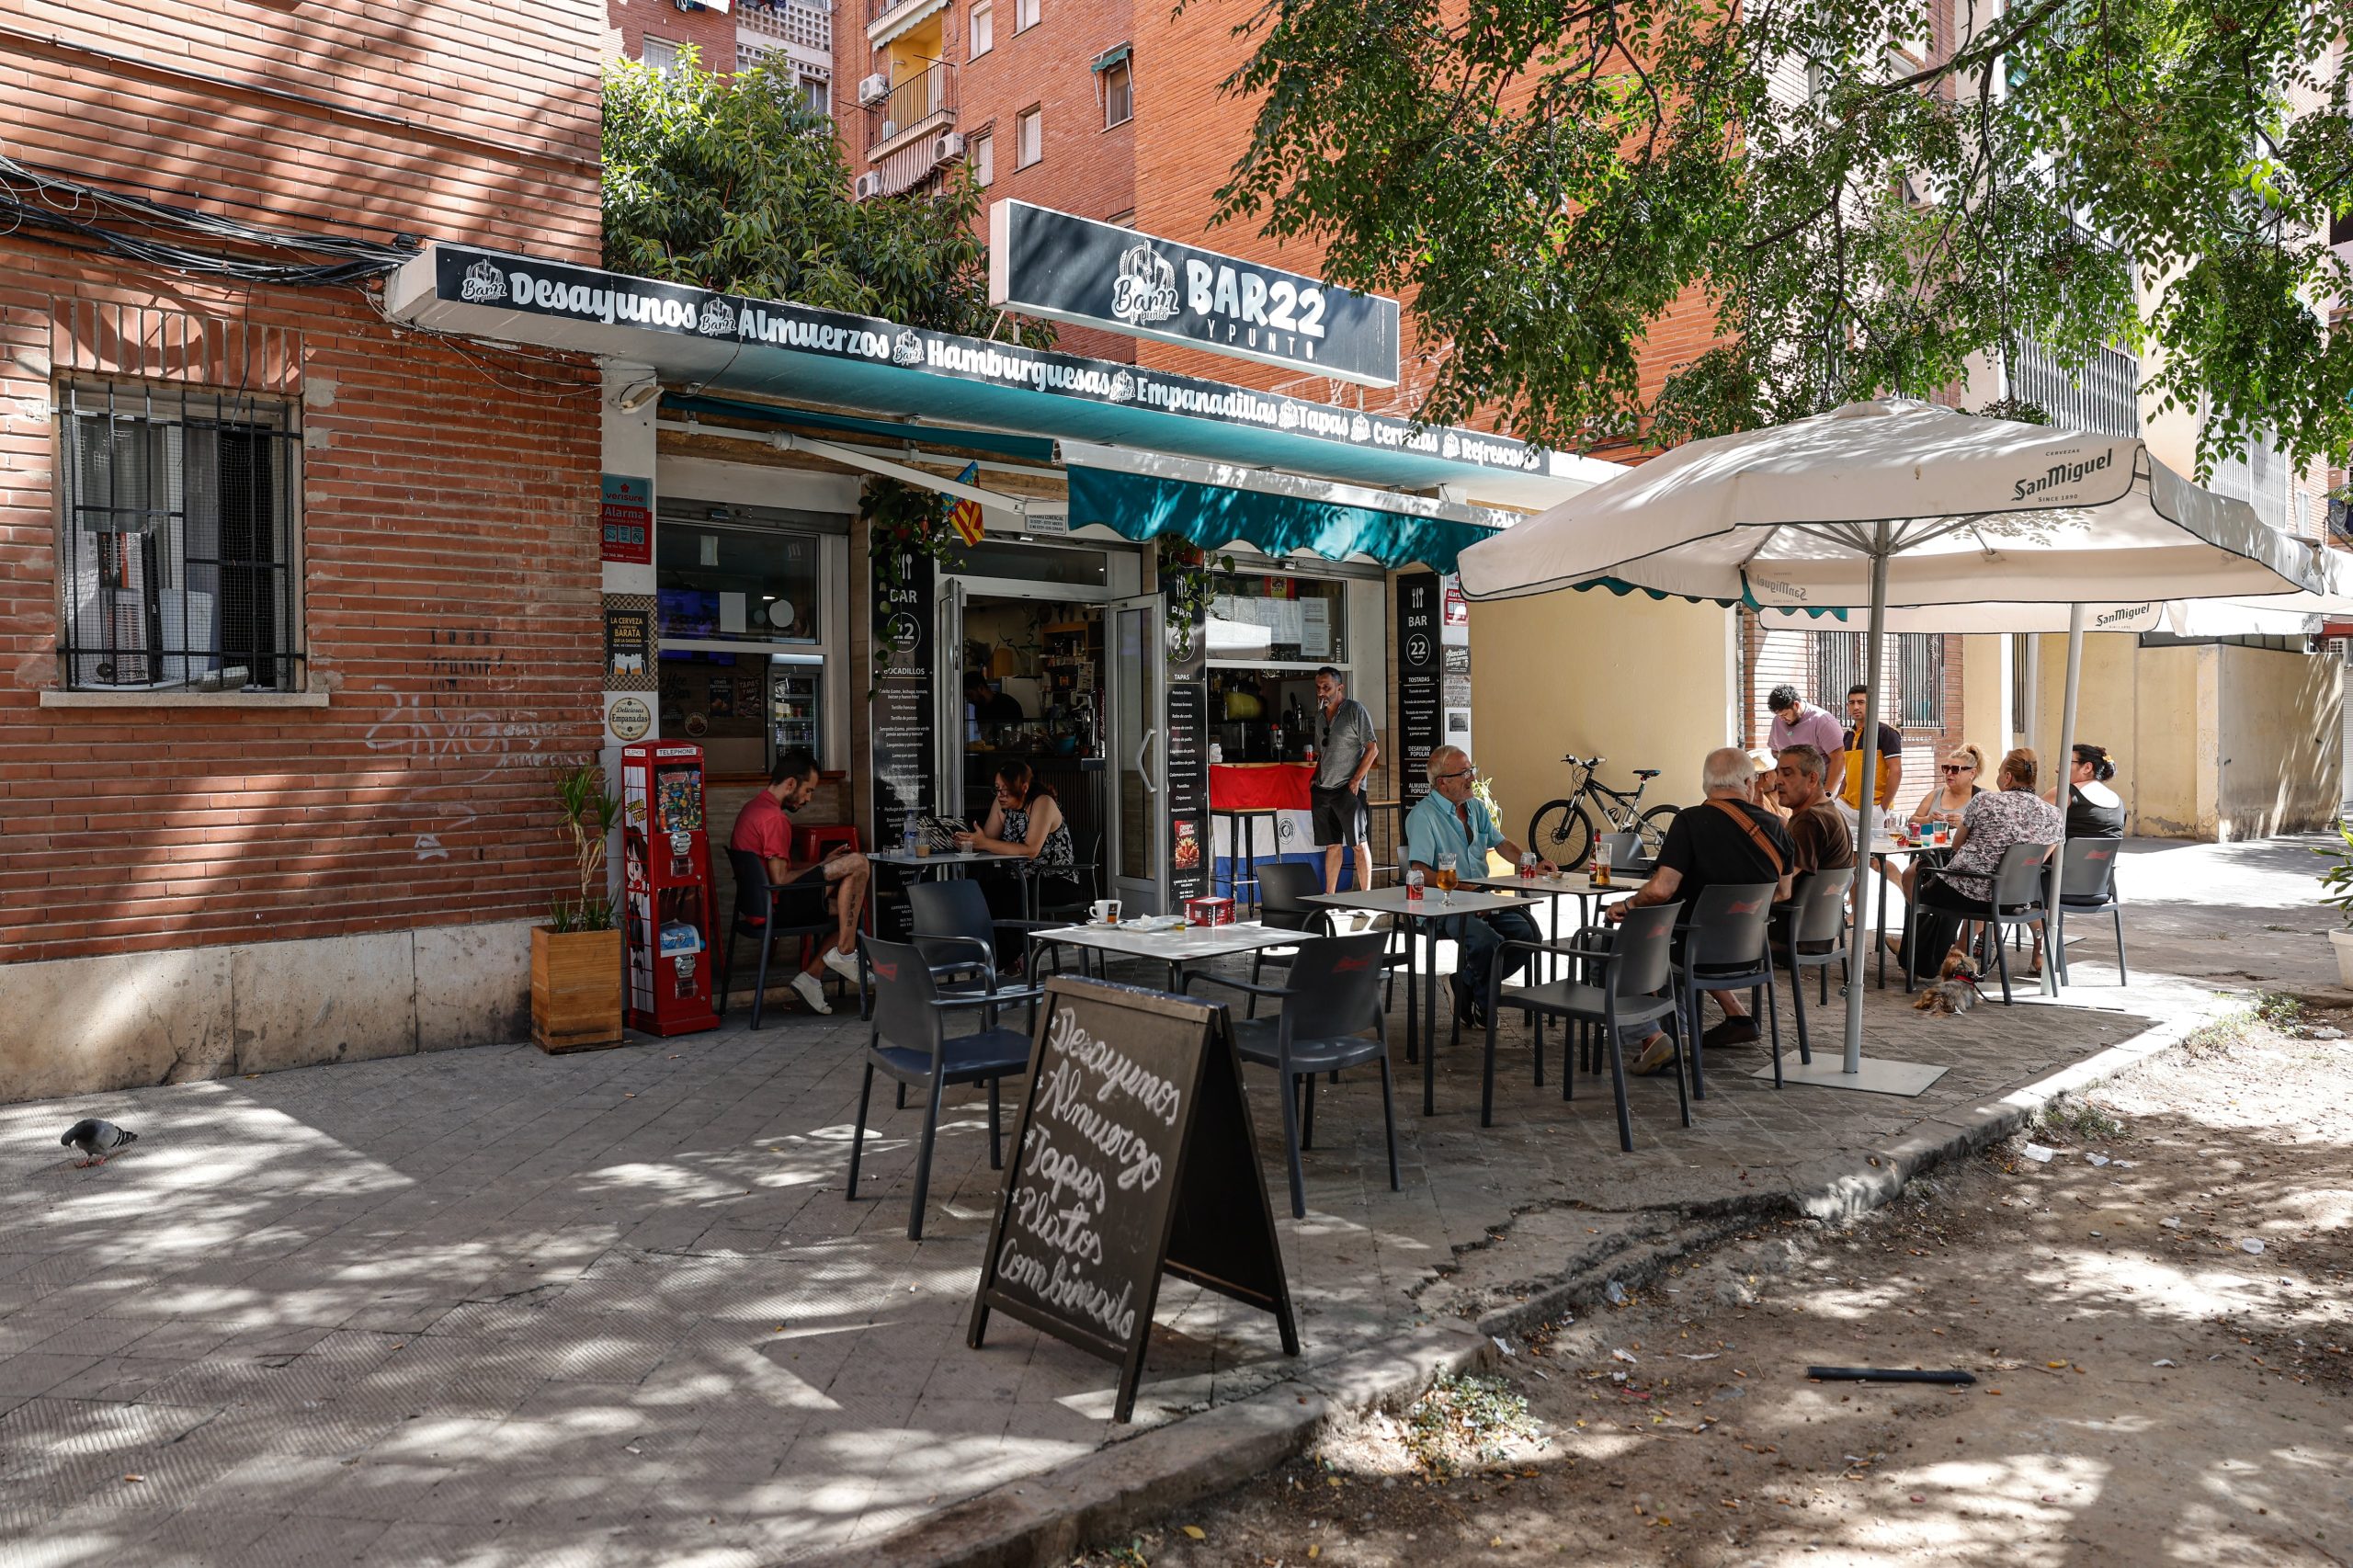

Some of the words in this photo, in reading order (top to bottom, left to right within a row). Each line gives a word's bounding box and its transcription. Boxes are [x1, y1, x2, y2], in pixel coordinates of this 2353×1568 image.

[462, 278, 507, 299] Bar22
[509, 272, 697, 329] Desayunos
[1115, 279, 1179, 315] Bar22
[1187, 259, 1325, 338] BAR22
[699, 314, 737, 334] Bar22
[1141, 306, 1169, 325] punto
[738, 309, 890, 358] Almuerzos
[892, 346, 925, 364] Bar22
[927, 339, 1110, 394] Hamburguesas
[1137, 377, 1278, 424] Empanadillas
[1298, 405, 1348, 436] Tapas
[1461, 438, 1524, 467] Refrescos
[2045, 449, 2081, 457] CERVEZAS
[606, 493, 645, 503] verisure
[604, 506, 644, 519] Alarma
[614, 629, 641, 637] BARATA
[619, 617, 643, 625] CERVEZA
[1408, 615, 1427, 627] BAR
[1411, 642, 1426, 655] 22
[1050, 1007, 1180, 1126] Desayunos
[1025, 1122, 1106, 1214] Tapas
[1017, 1187, 1103, 1266] Platos
